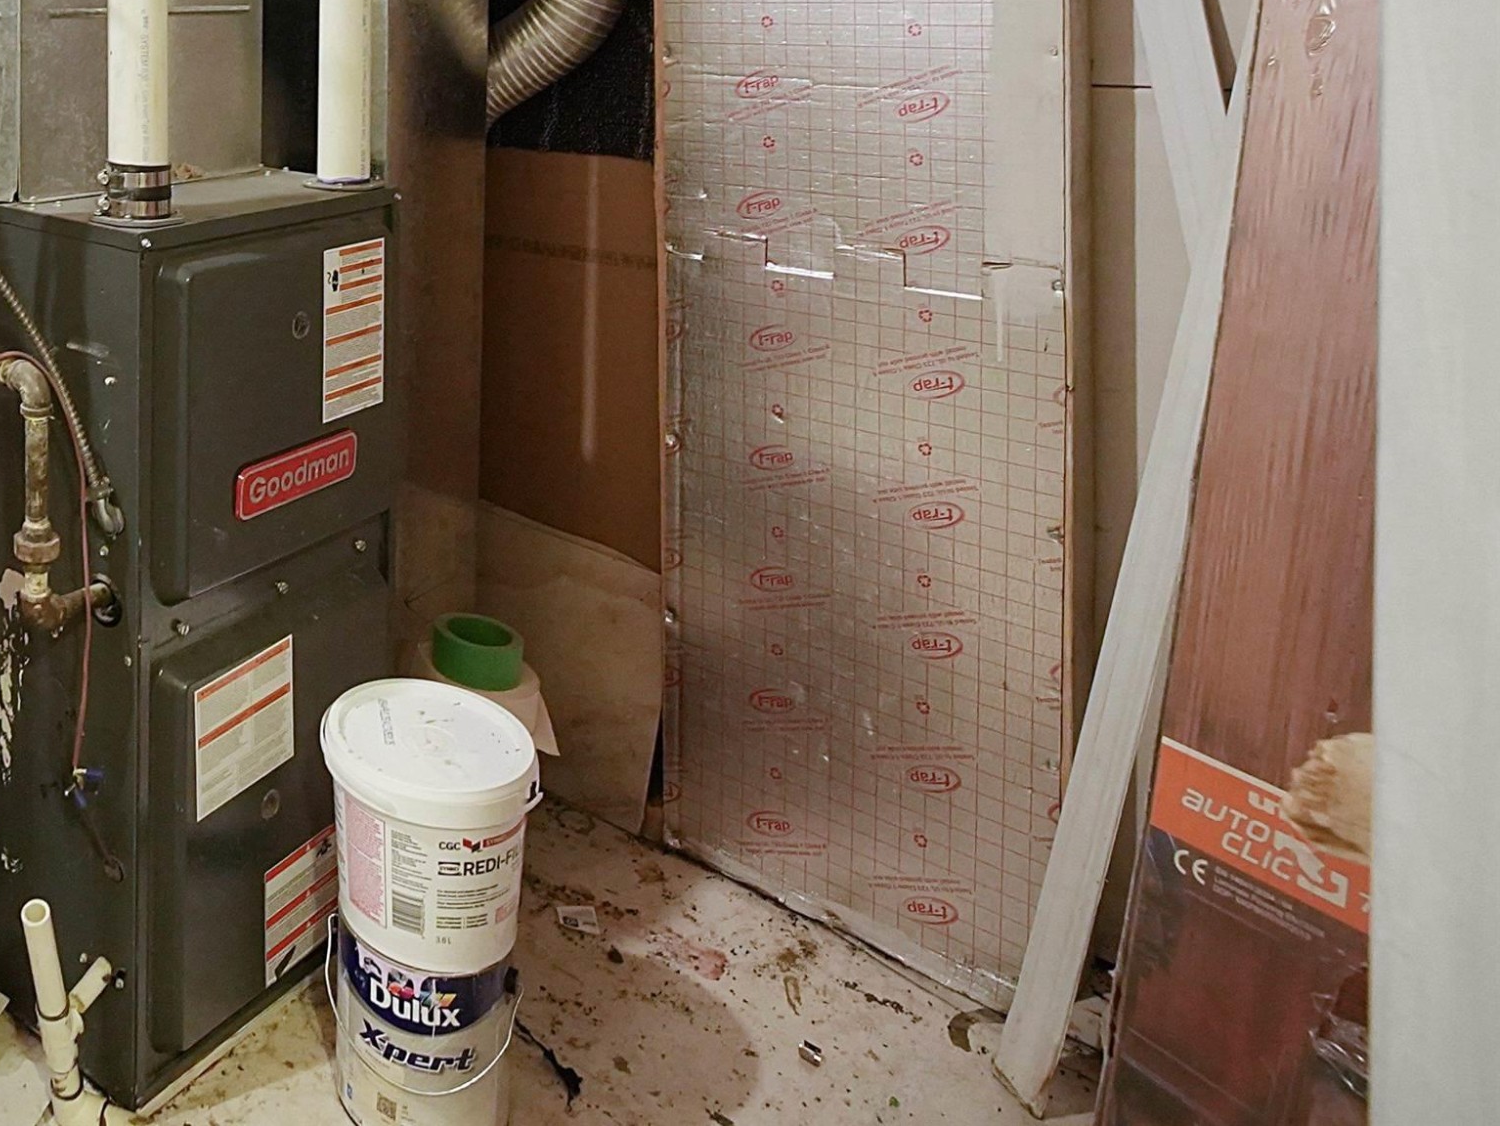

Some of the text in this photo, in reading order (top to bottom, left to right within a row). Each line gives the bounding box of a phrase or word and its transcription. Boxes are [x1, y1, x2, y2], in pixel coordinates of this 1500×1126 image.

[249, 449, 349, 504] Goodman
[438, 841, 461, 851] CGC
[1221, 830, 1294, 882] CLIC
[370, 977, 460, 1028] Dulux
[359, 1017, 476, 1073] X-pert
